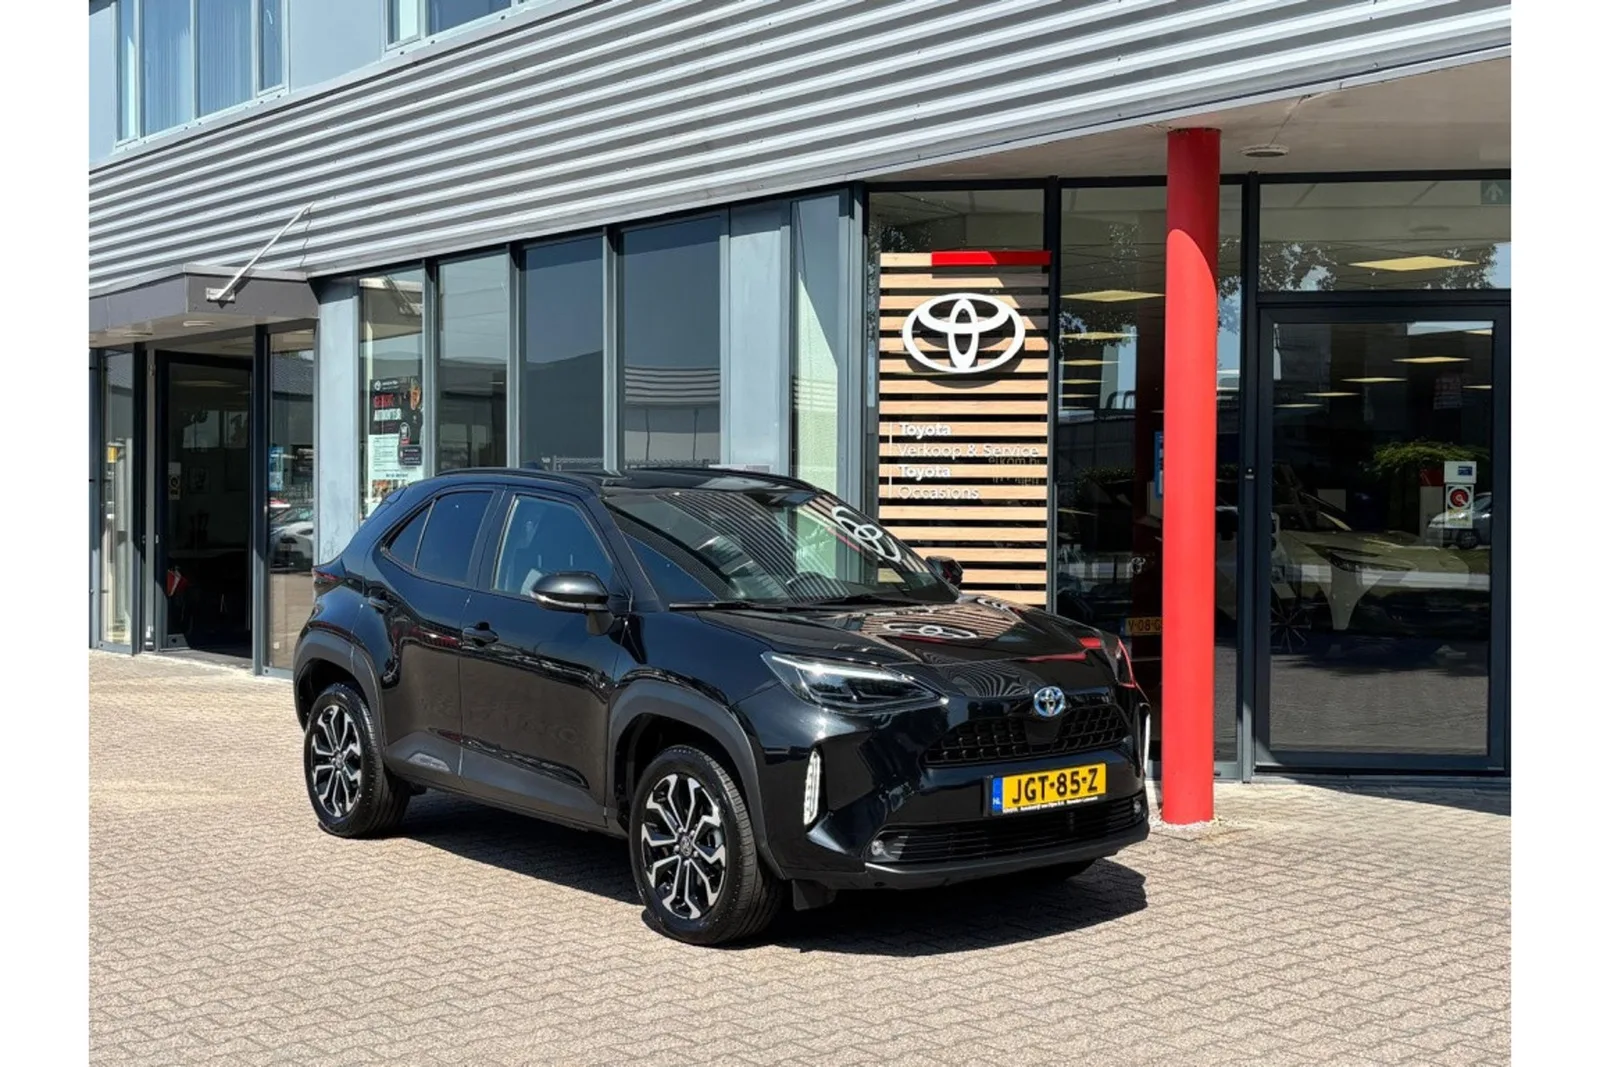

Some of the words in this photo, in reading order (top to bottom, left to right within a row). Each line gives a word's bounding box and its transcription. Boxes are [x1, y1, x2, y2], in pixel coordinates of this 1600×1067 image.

[899, 422, 951, 439] Toyota
[897, 443, 961, 460] Verkoop
[966, 444, 978, 457] &
[983, 443, 1039, 457] Service
[899, 464, 951, 481] Toyota
[899, 486, 980, 500] Occasions
[1012, 767, 1099, 804] JGT-85-Z
